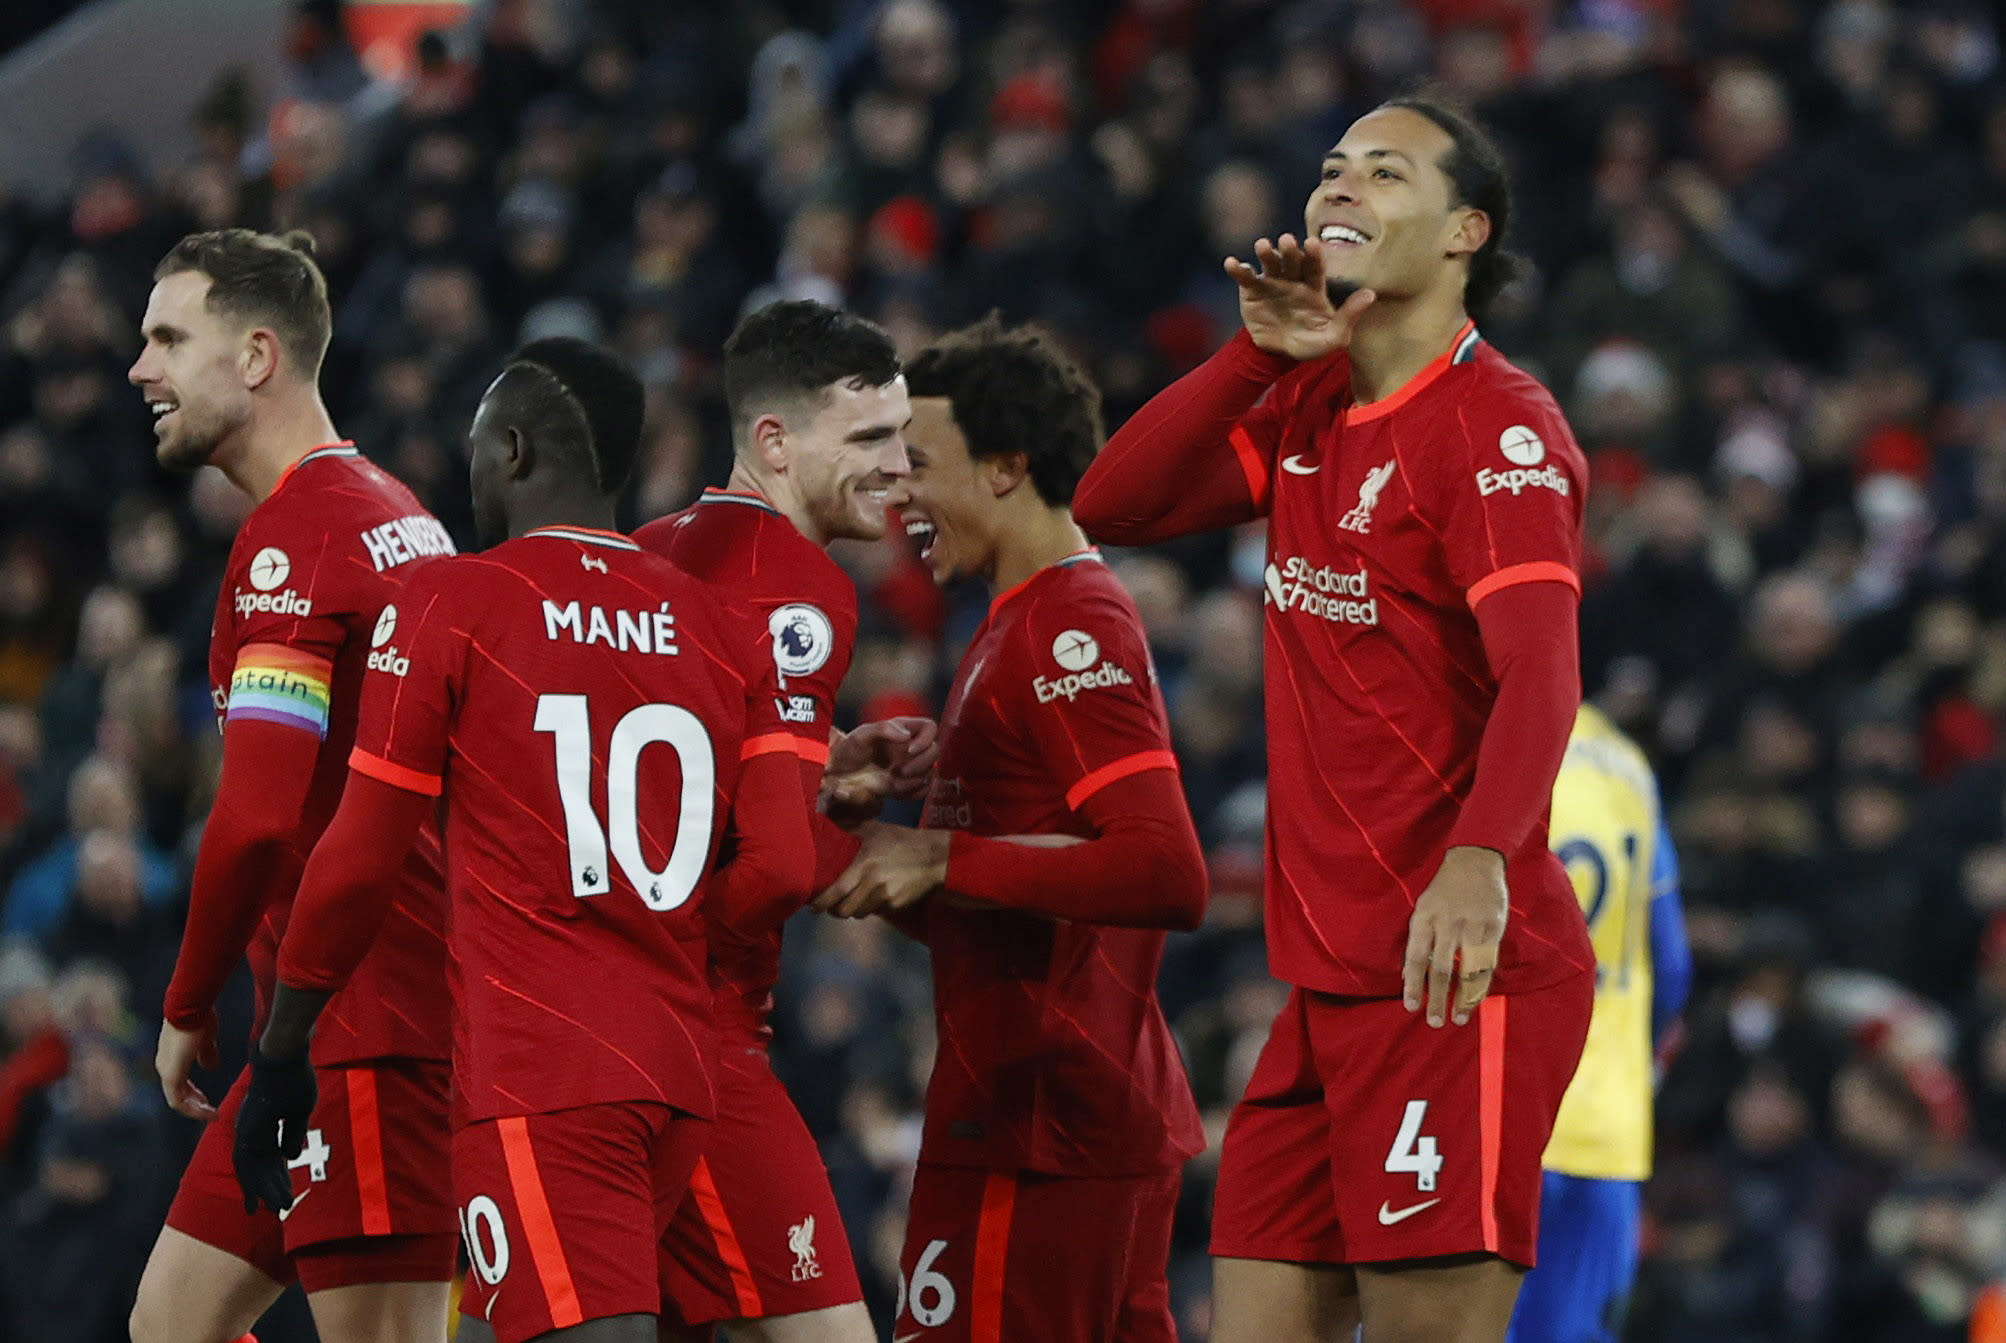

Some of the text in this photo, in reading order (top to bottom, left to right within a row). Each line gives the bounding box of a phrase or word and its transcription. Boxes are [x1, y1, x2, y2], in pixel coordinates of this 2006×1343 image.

[1475, 463, 1570, 496] Expedia
[541, 600, 680, 656] MANÉ
[533, 693, 716, 913] 10
[1383, 1099, 1445, 1193] 4
[458, 1194, 510, 1293] 0
[894, 1239, 957, 1327] 6
